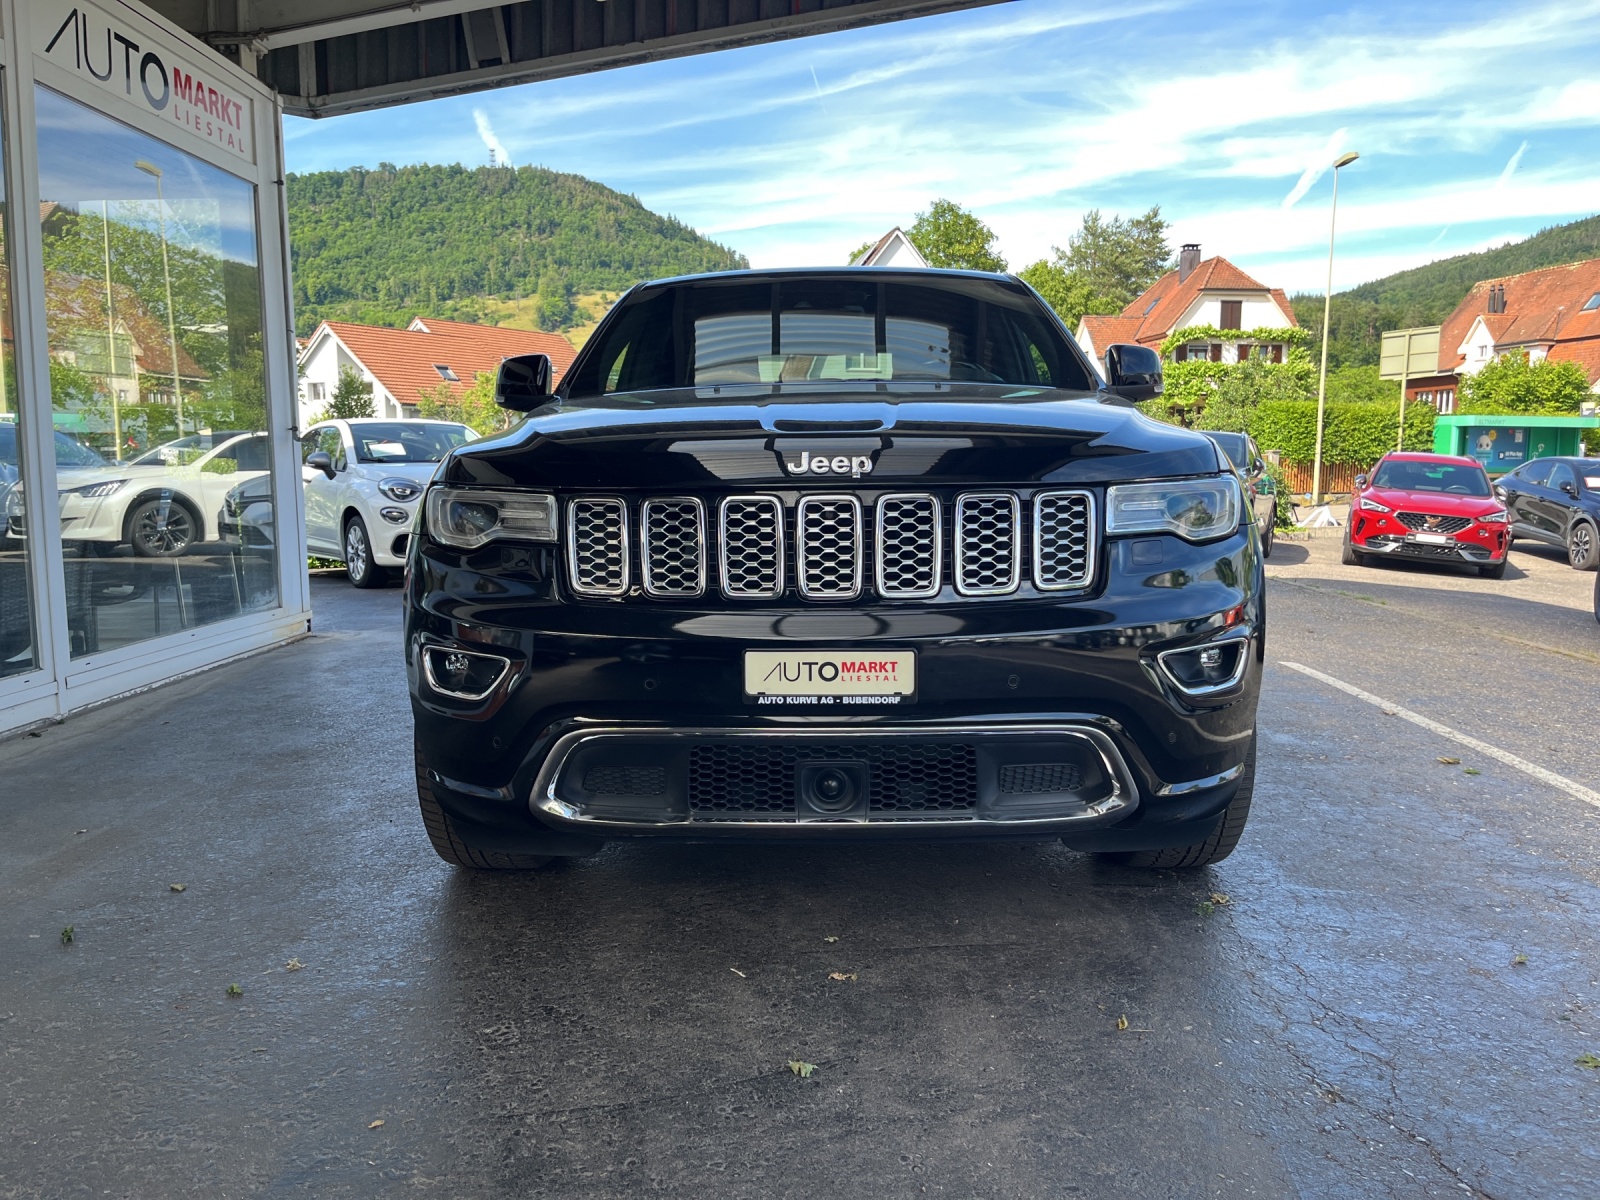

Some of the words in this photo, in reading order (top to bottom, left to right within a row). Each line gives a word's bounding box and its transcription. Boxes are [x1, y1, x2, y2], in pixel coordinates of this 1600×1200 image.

[45, 8, 169, 111] AUTO
[173, 66, 242, 130] MARKT
[174, 104, 244, 153] LIESTAL
[787, 451, 873, 479] Jeep
[763, 661, 839, 682] AUTO
[841, 661, 898, 673] MARKT
[757, 696, 784, 704] AUTO
[786, 696, 818, 704] KURVE
[820, 696, 834, 704] AG
[842, 696, 901, 704] BUBENDORF
